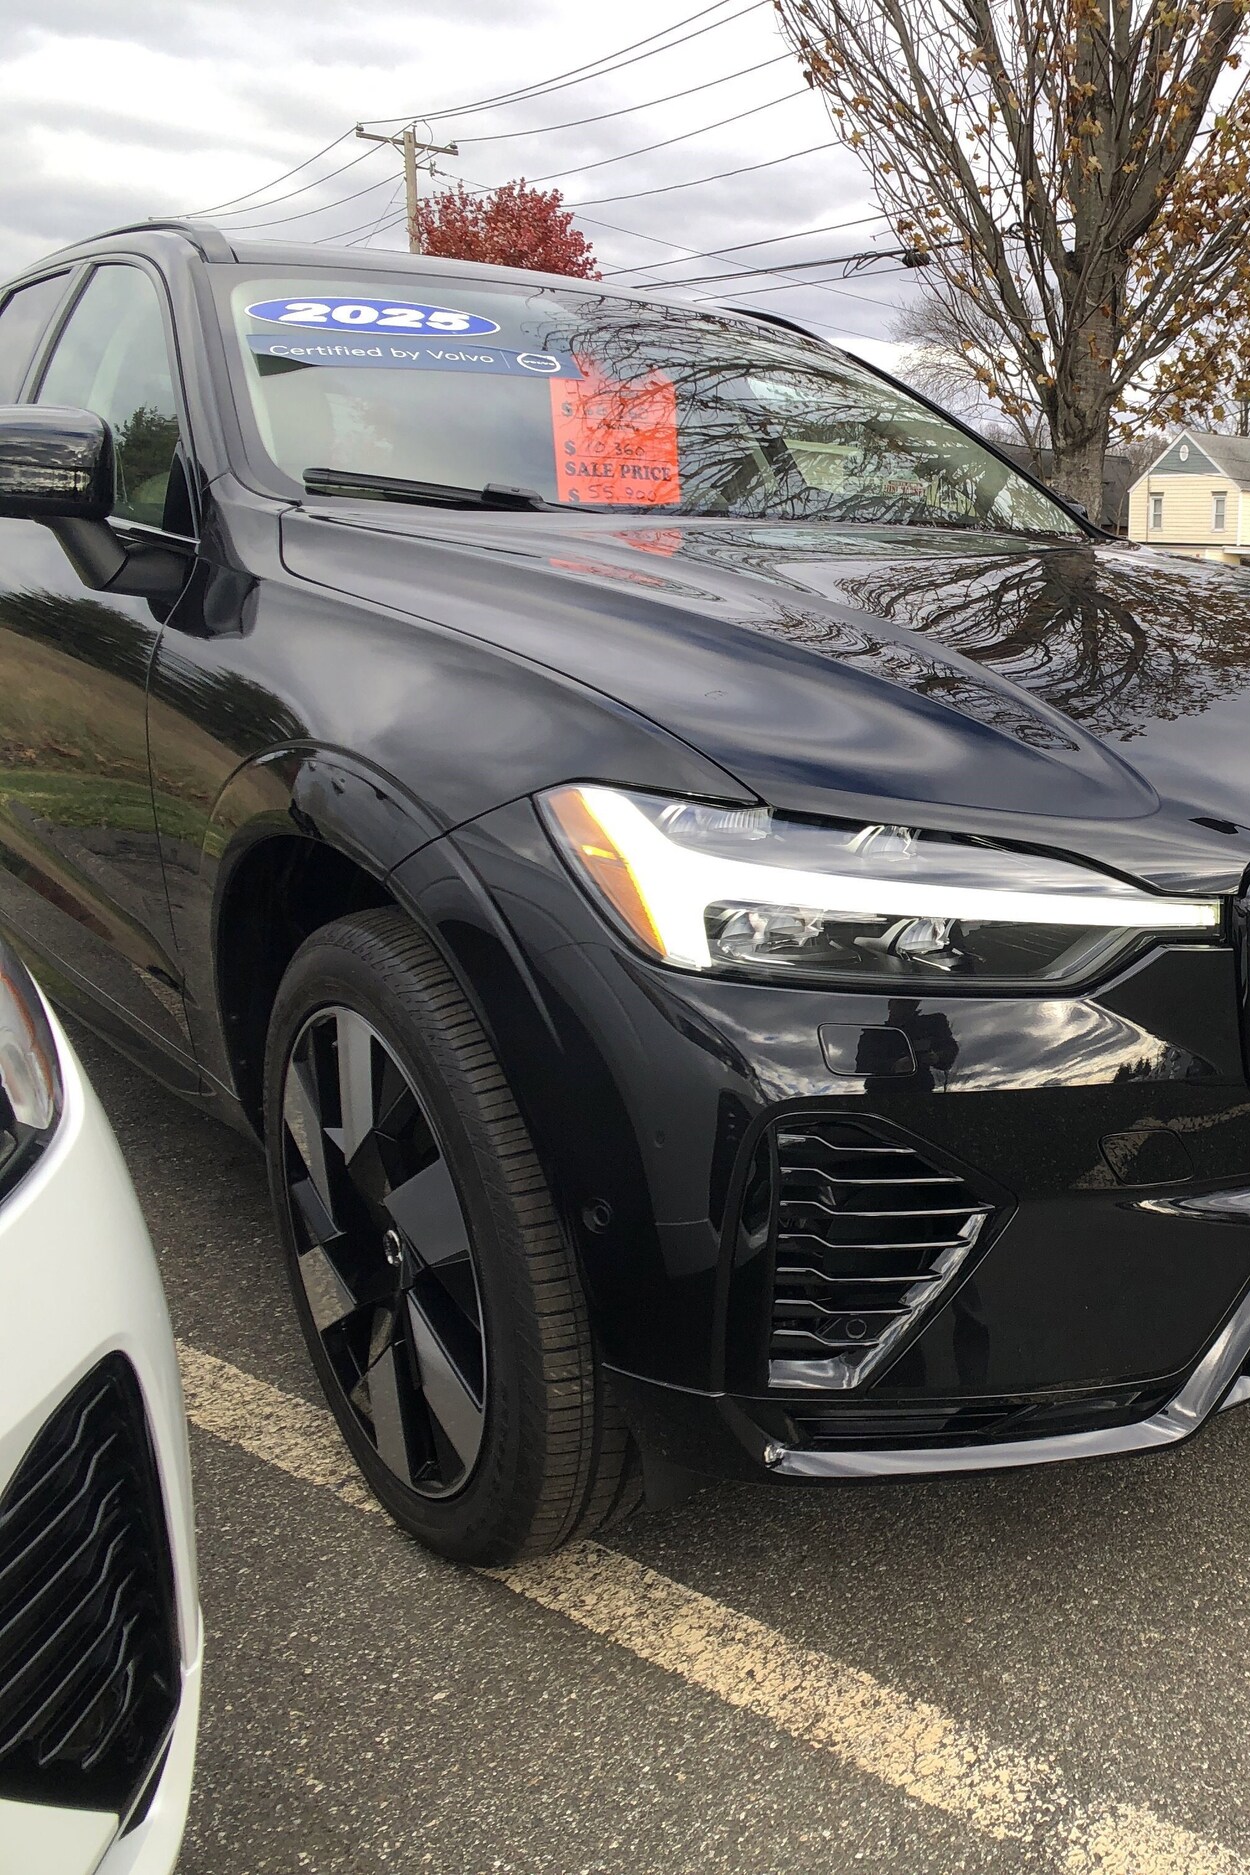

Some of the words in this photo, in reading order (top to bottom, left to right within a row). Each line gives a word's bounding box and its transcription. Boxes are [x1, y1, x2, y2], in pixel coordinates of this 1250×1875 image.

[278, 302, 471, 331] 2025
[269, 344, 383, 358] Certified
[391, 347, 421, 361] by
[427, 349, 494, 363] Volvo
[564, 440, 576, 456] $
[565, 461, 615, 477] SALE
[620, 463, 672, 481] PRICE
[568, 487, 580, 502] $
